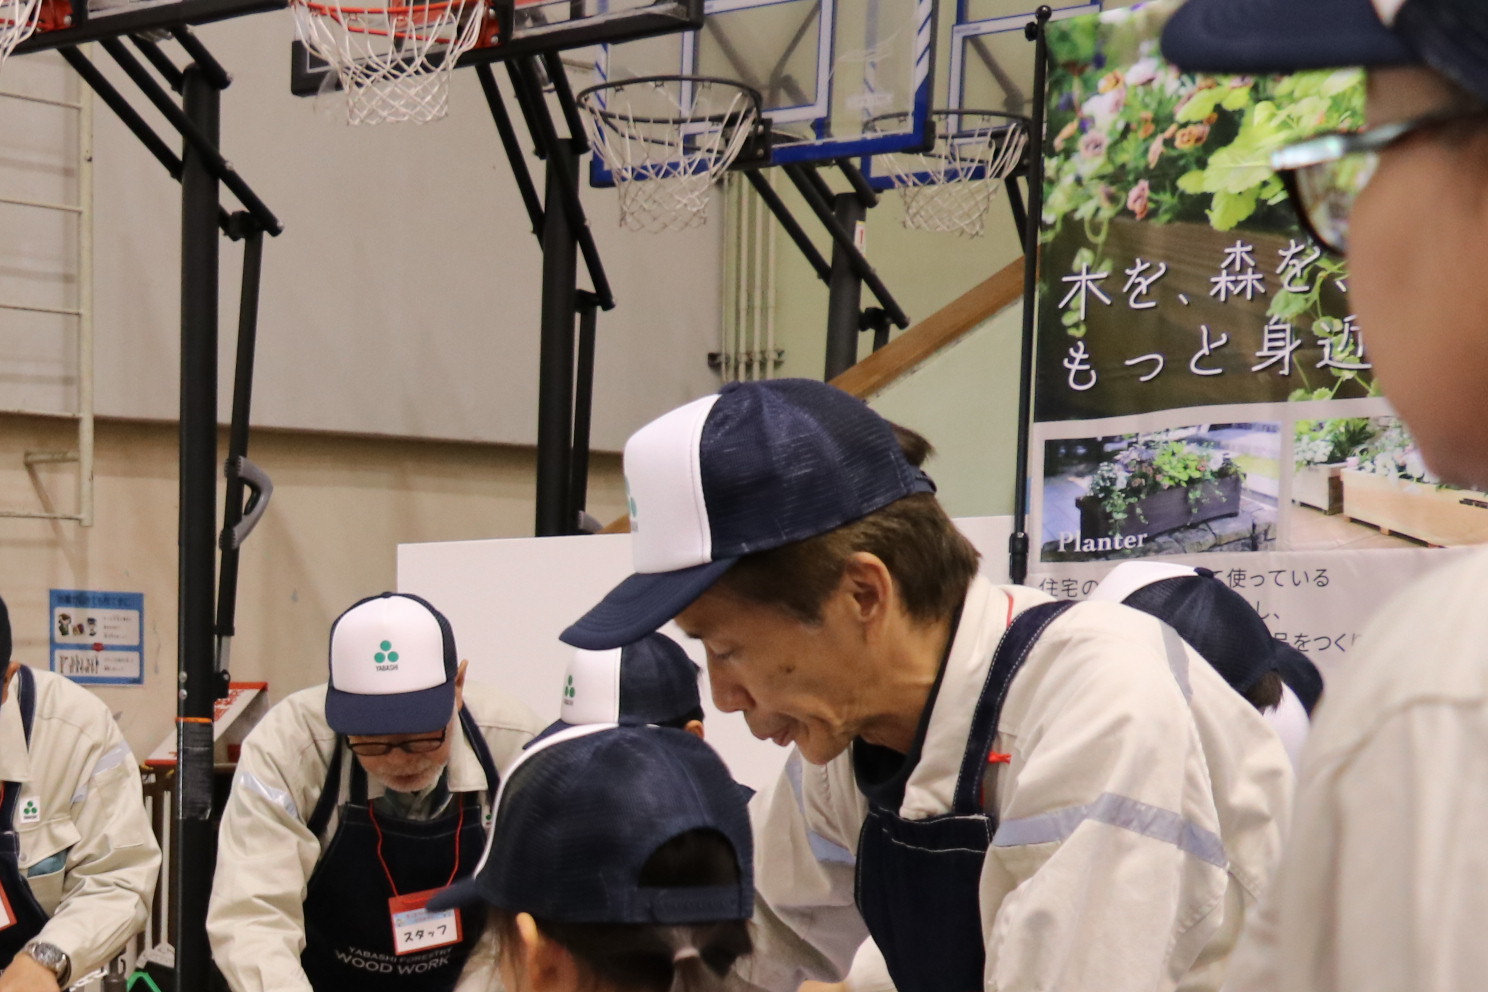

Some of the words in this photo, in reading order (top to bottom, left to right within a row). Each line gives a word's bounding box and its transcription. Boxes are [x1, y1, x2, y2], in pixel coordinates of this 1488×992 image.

[1058, 239, 1347, 321] 木を、森を、
[1063, 315, 1373, 392] もっと身近
[1057, 530, 1149, 553] Planter
[1039, 578, 1099, 598] 住宅の
[404, 924, 447, 943] スタッフ
[335, 949, 393, 973] WOOD
[397, 956, 449, 975] WORK
[349, 946, 397, 963] YABASHI
